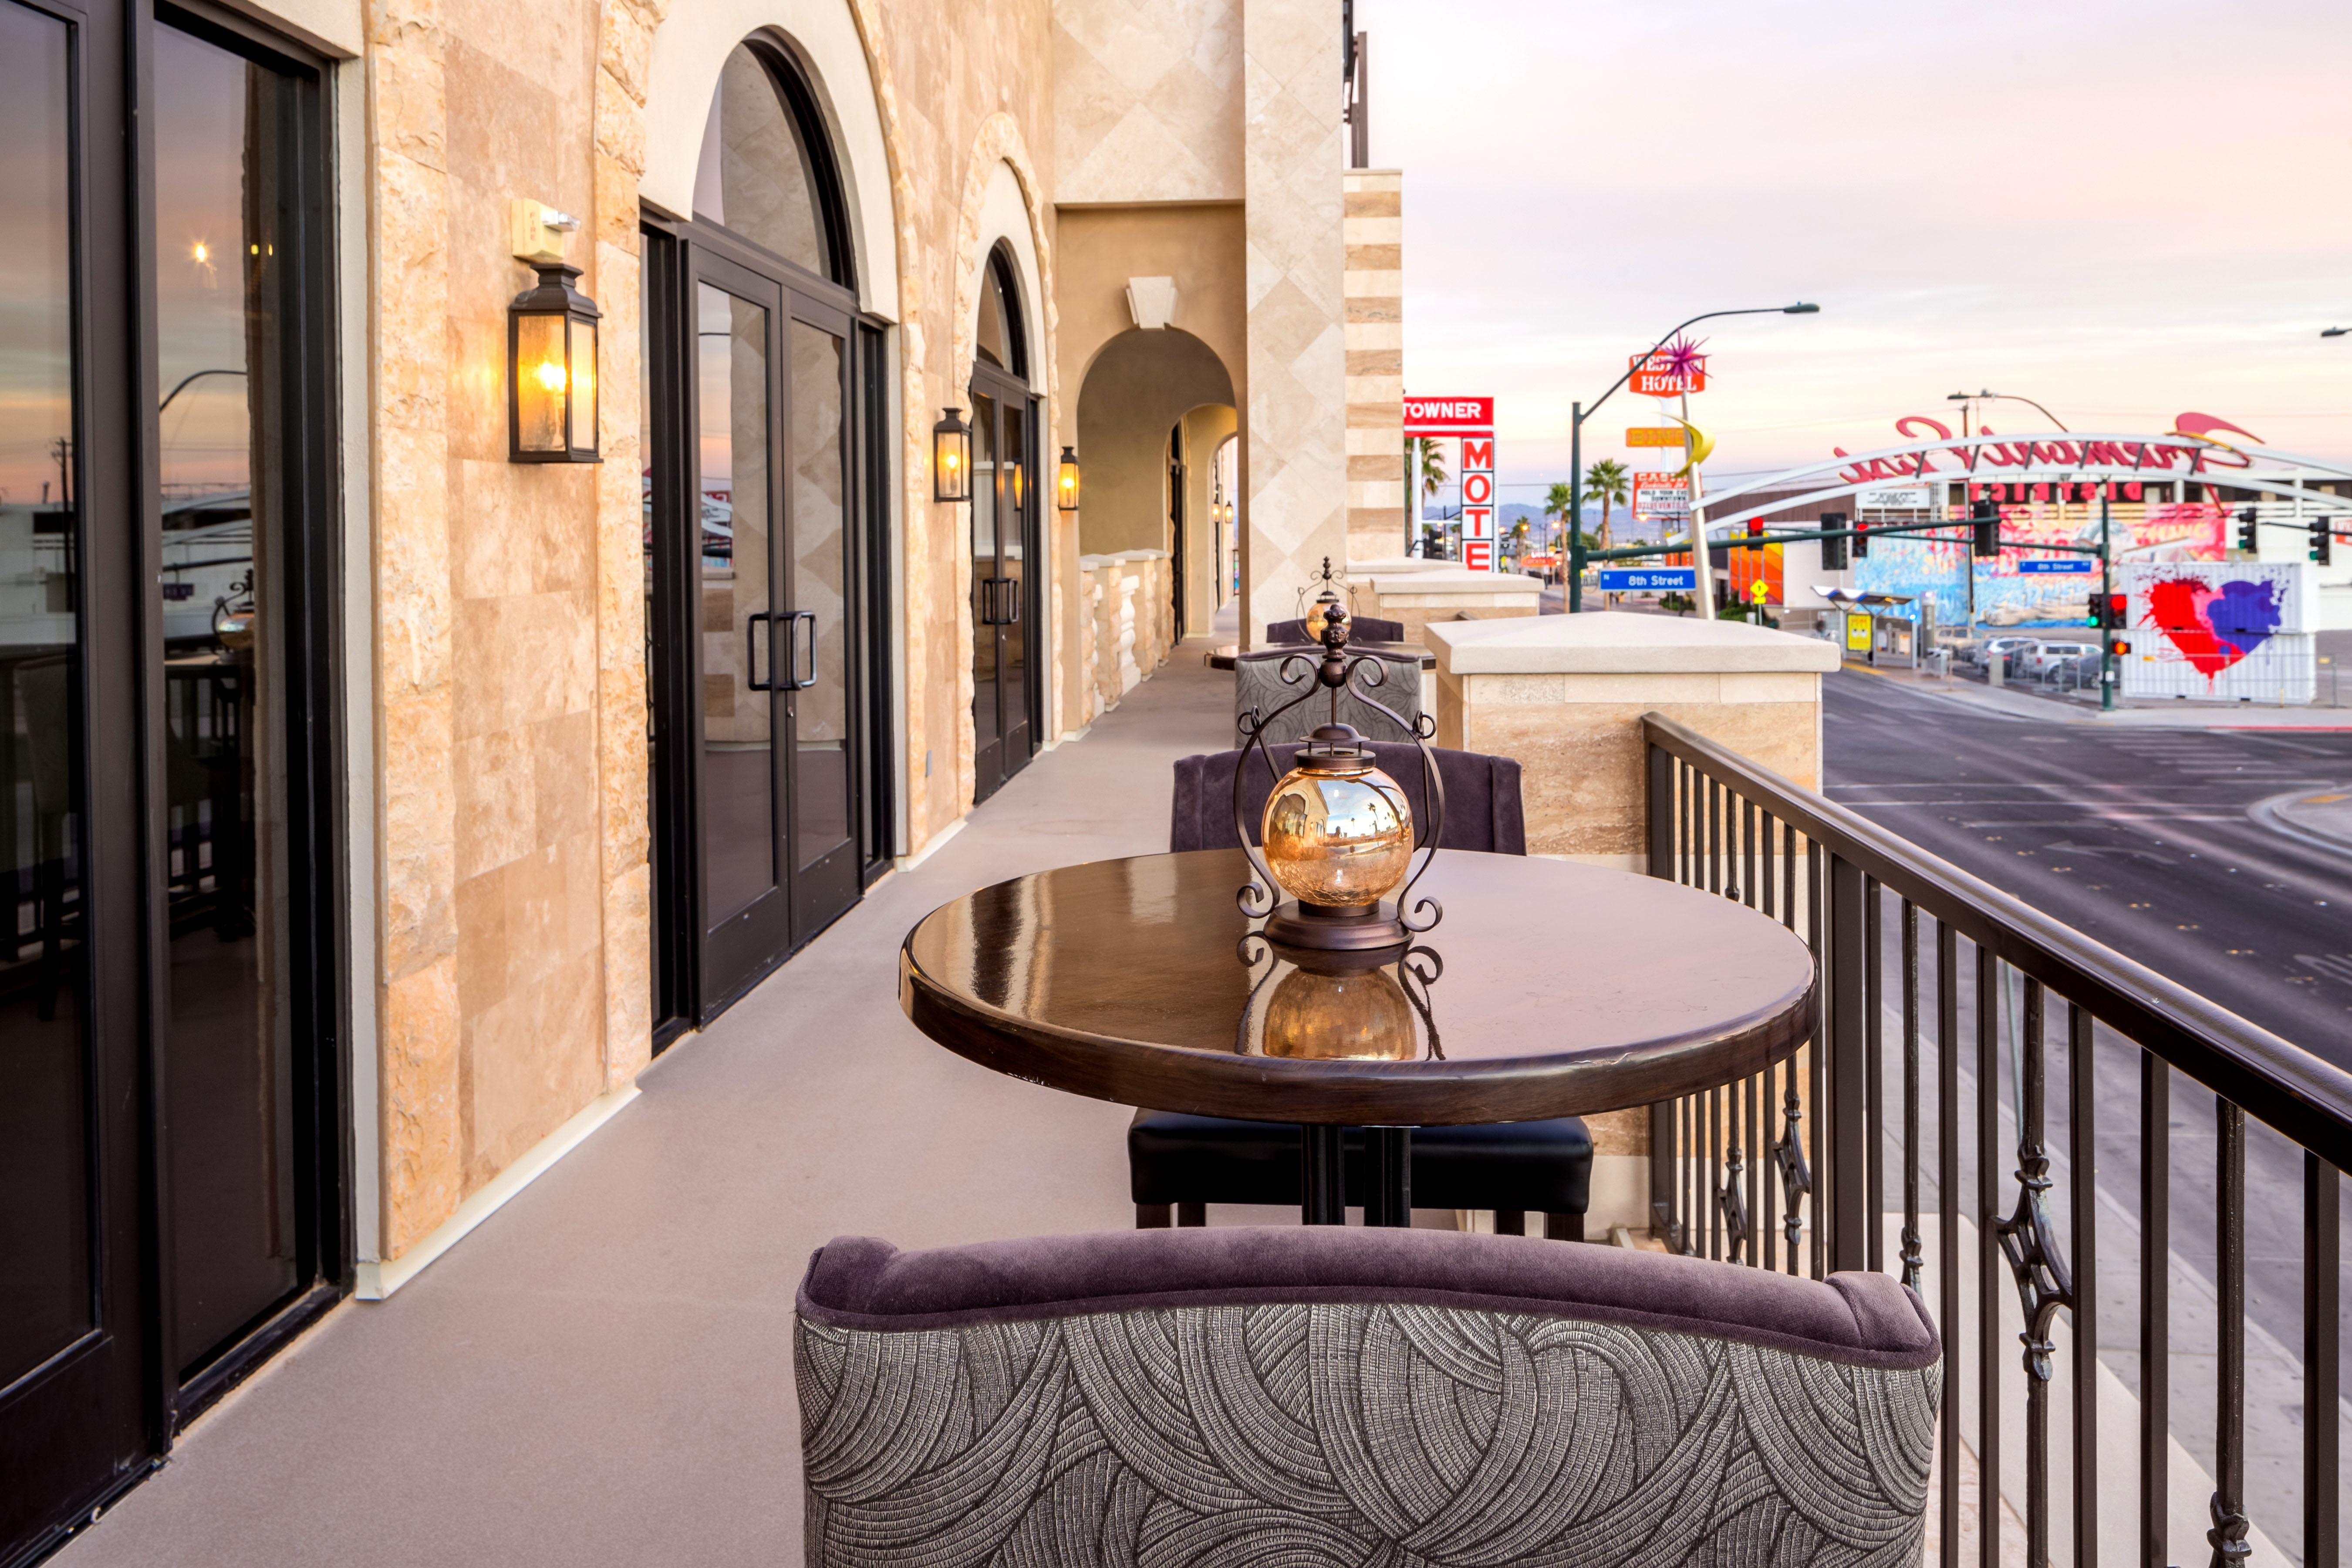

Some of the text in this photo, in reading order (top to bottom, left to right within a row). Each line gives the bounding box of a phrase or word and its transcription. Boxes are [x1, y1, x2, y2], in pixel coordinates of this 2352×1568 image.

[1633, 355, 1703, 371] WESTN
[1641, 375, 1697, 391] HOTEL
[1402, 402, 1481, 418] TOWNER
[1628, 575, 1647, 586] 8th
[1651, 575, 1684, 586] Street
